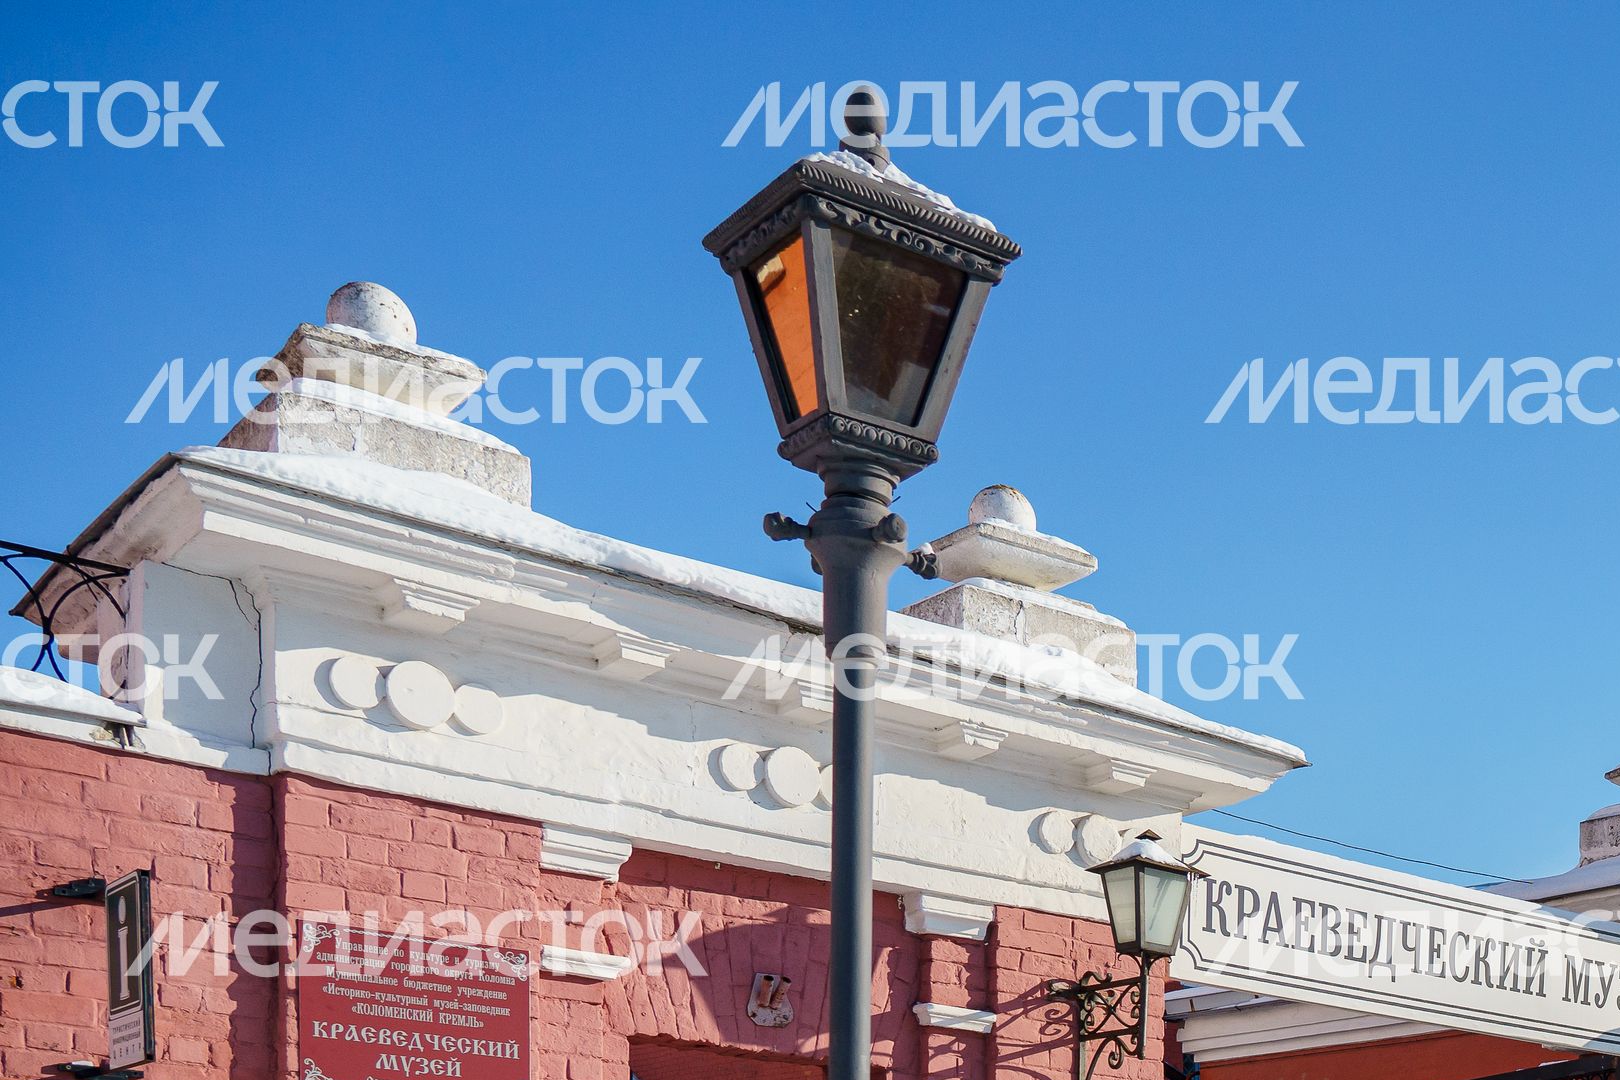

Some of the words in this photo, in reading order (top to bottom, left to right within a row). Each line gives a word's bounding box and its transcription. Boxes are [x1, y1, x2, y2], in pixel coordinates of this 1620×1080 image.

[1201, 877, 1549, 997] КРАЕВЕДЧЕСКИЙ
[316, 952, 386, 970] администрации
[391, 962, 440, 976] городского
[444, 968, 474, 981] округа
[479, 970, 516, 986] Коломна
[335, 937, 388, 955] Управление
[393, 948, 404, 958] по
[410, 950, 449, 964] культуре
[454, 956, 459, 965] и
[464, 958, 500, 972] туризму
[322, 982, 428, 1006] «Историко-культурный
[434, 998, 510, 1016] музей-заповедник
[326, 966, 398, 987] Муниципальное
[404, 977, 452, 993] бюджетное
[457, 985, 507, 1000] учреждение
[352, 1002, 433, 1023] «КОЛОМЕНСКИЙ
[439, 1012, 484, 1028] КРЕМЛЬ»
[312, 1020, 520, 1060] КРАЕВЕДЧЕСКИЙ
[376, 1053, 462, 1078] МУЗЕЙ
